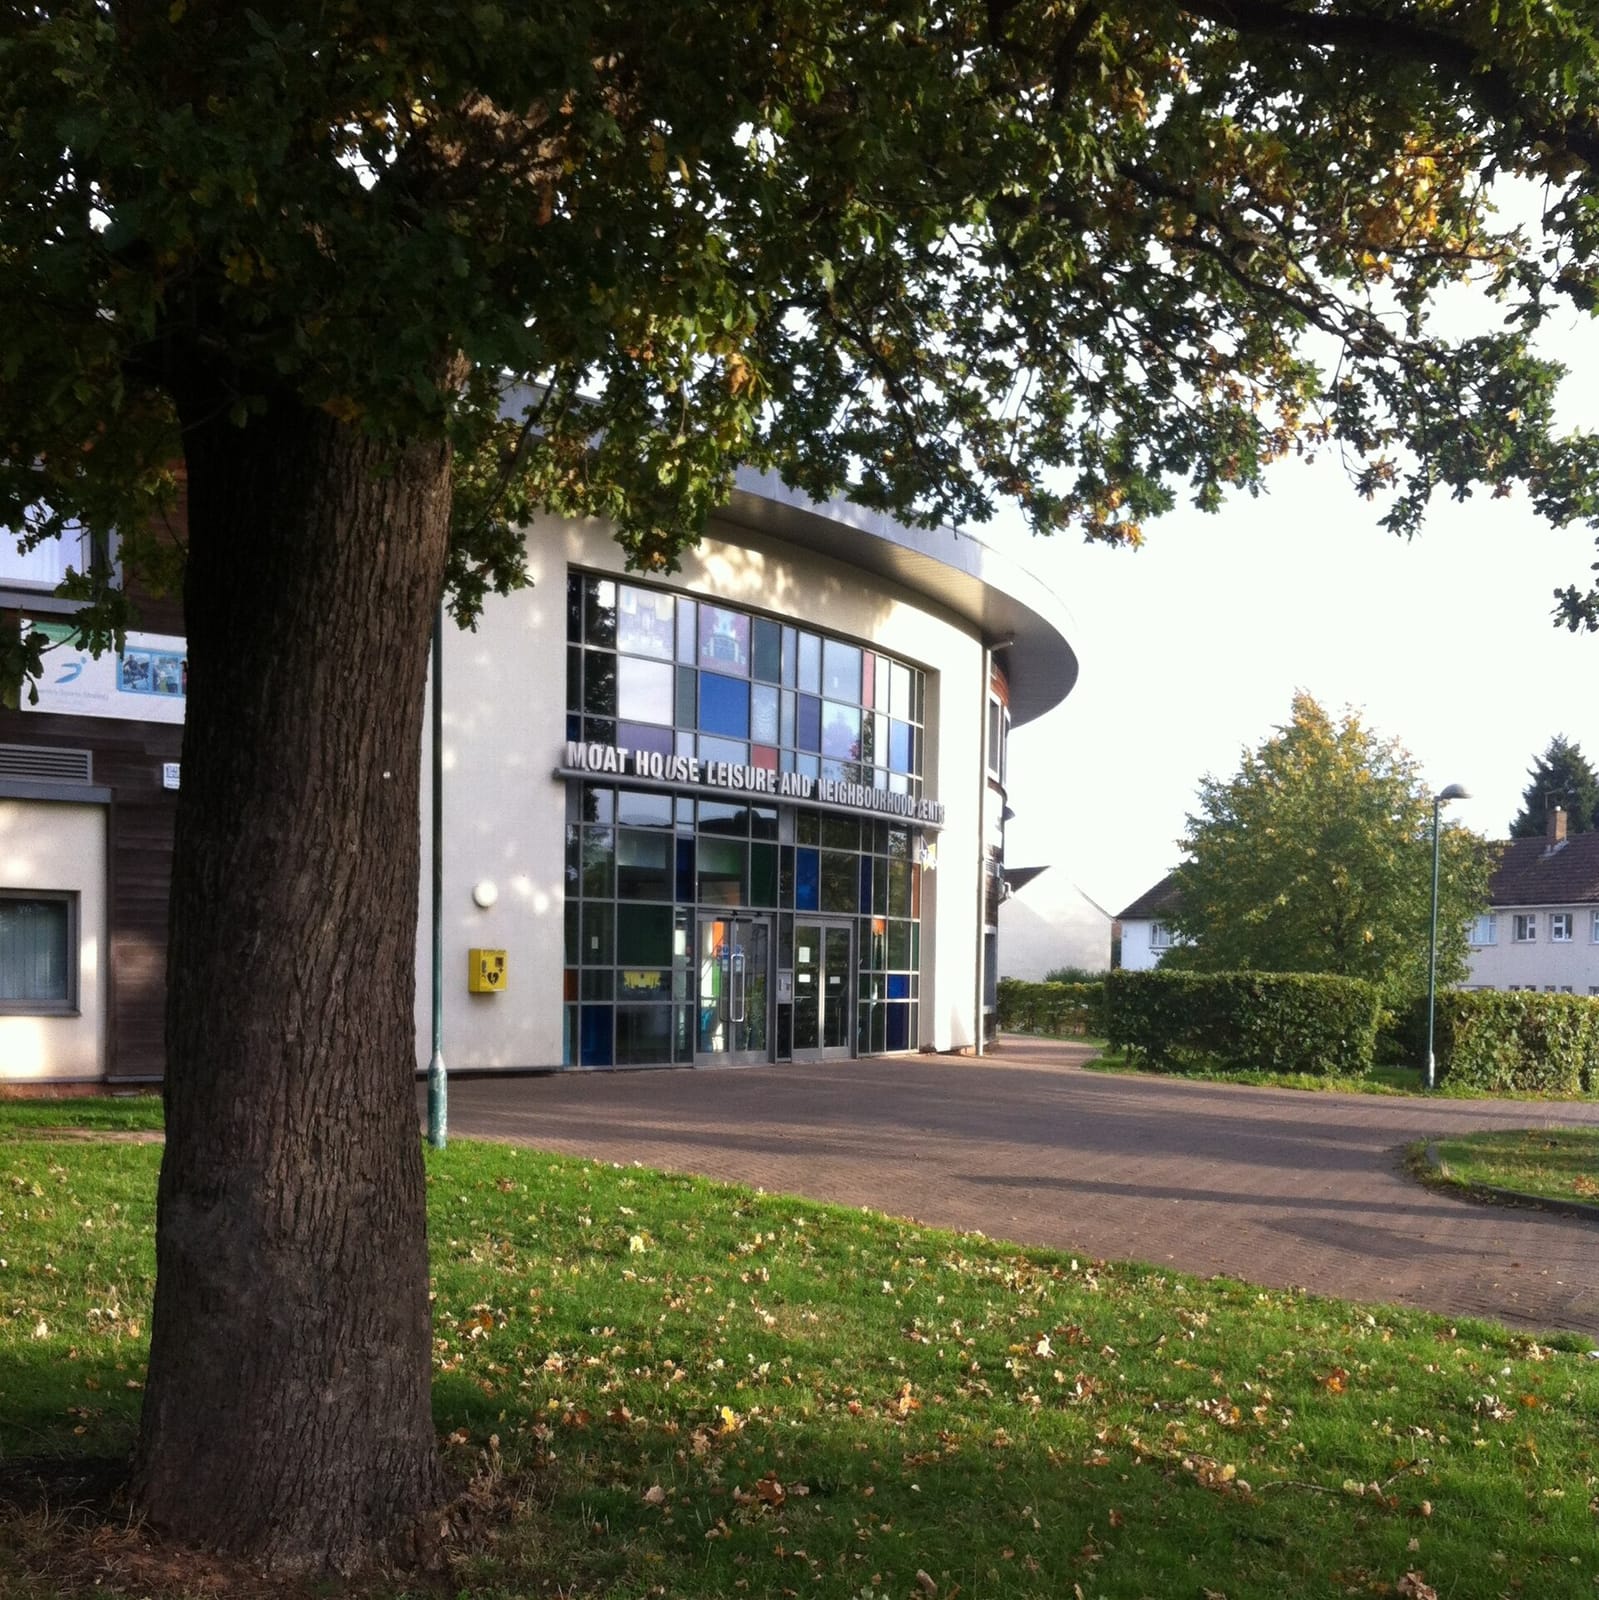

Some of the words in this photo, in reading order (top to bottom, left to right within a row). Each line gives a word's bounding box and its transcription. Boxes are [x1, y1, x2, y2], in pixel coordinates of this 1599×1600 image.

[567, 740, 629, 773] MOAT
[636, 750, 699, 782] HOUSE
[707, 760, 776, 793] LEISURE
[781, 771, 812, 798] AND
[818, 778, 914, 816] NEIGHBOURHOOD
